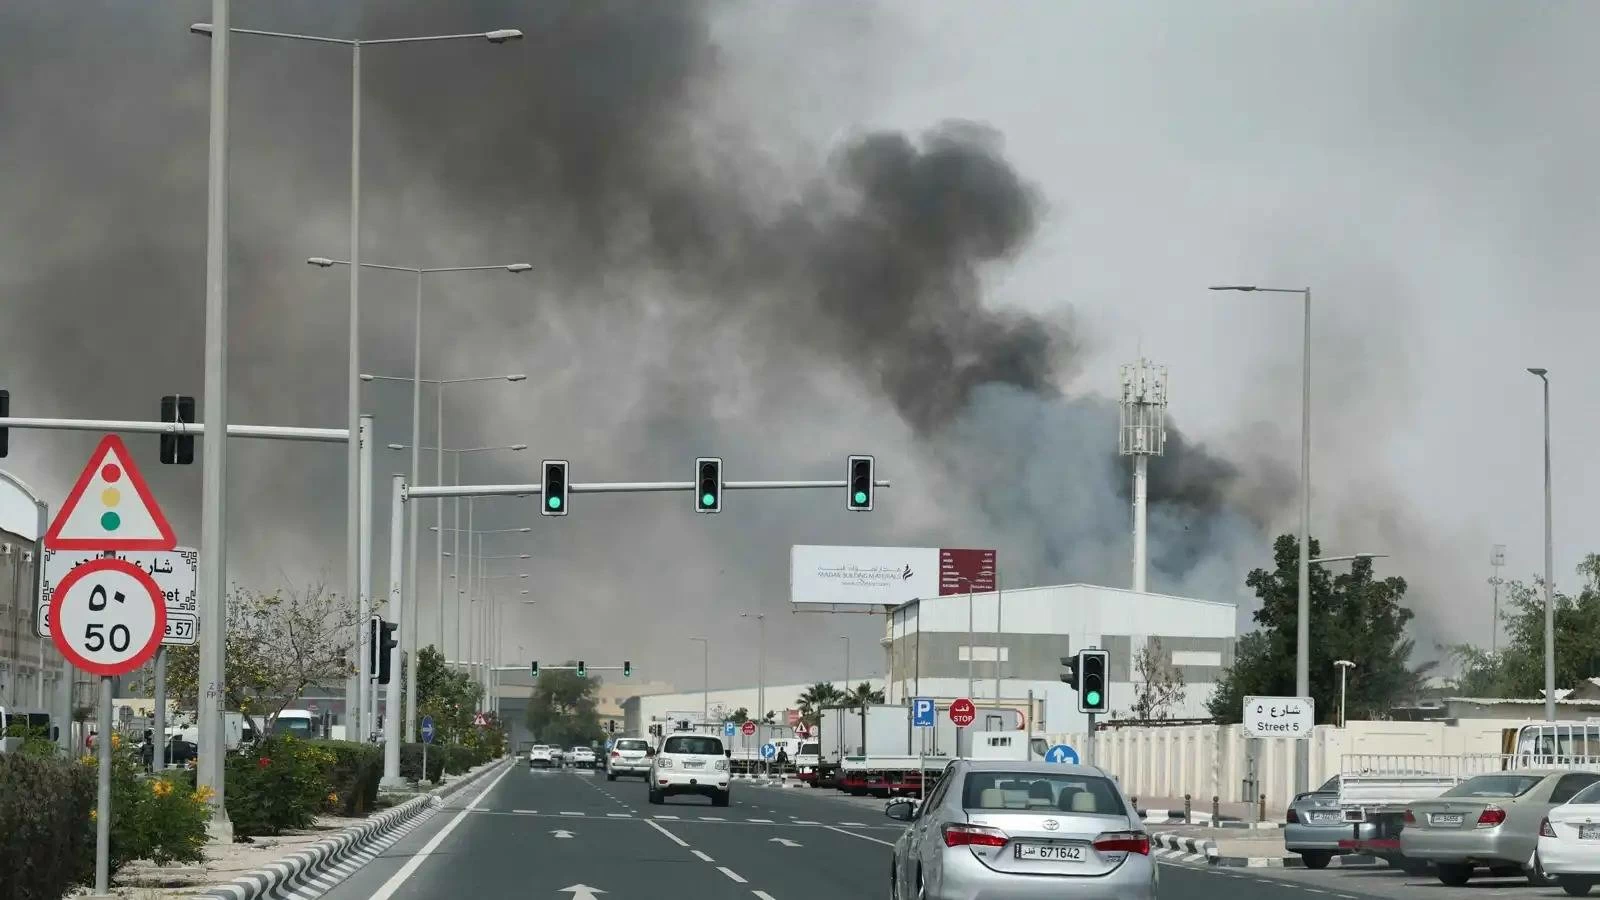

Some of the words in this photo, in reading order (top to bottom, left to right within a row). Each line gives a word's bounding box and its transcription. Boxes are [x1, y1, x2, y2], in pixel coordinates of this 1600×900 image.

[88, 583, 127, 612] ٥٠
[176, 622, 191, 636] 57
[84, 623, 131, 652] 50
[917, 701, 931, 718] P
[955, 703, 970, 712] قف
[1270, 705, 1301, 718] شارع
[1257, 722, 1289, 731] Street
[1292, 722, 1299, 731] 5
[1040, 846, 1080, 859] 671642
